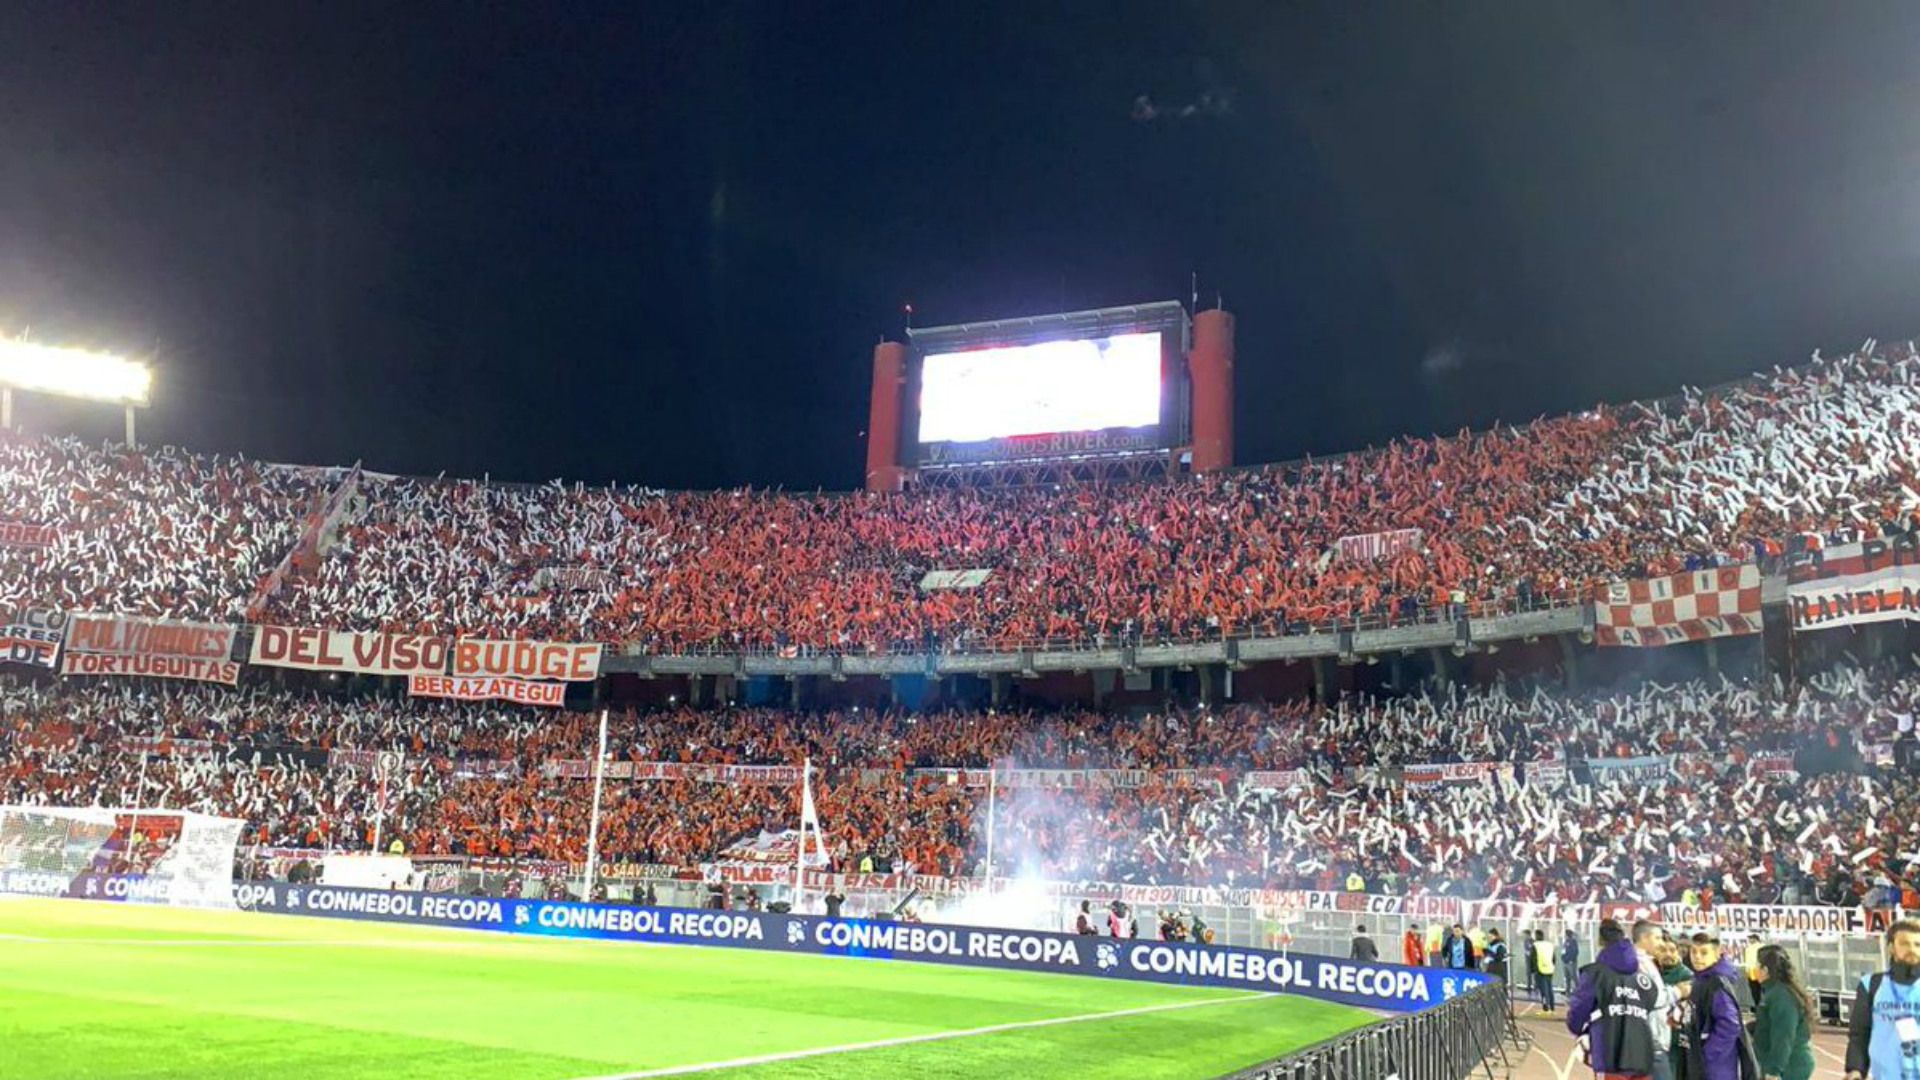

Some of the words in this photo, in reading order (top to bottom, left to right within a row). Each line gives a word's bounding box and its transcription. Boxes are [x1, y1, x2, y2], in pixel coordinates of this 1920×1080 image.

[1791, 586, 1920, 628] RANELA
[259, 626, 344, 666] DEL
[353, 634, 446, 671] VISO
[456, 641, 598, 679] BUDGE
[66, 653, 237, 682] TORTUGUITAS
[413, 676, 562, 702] BERAZATEGUI
[721, 866, 773, 882] PILAR
[307, 890, 417, 916] CONMEBOL
[421, 896, 502, 921] RECOPA
[538, 905, 665, 936] CONMEBOL
[669, 914, 763, 941] RECOPA
[815, 920, 963, 956] CONMEBOL
[968, 931, 1080, 966] RECOPA
[1130, 945, 1312, 988] CONMEBOL
[1318, 963, 1430, 1002] RECOPA
